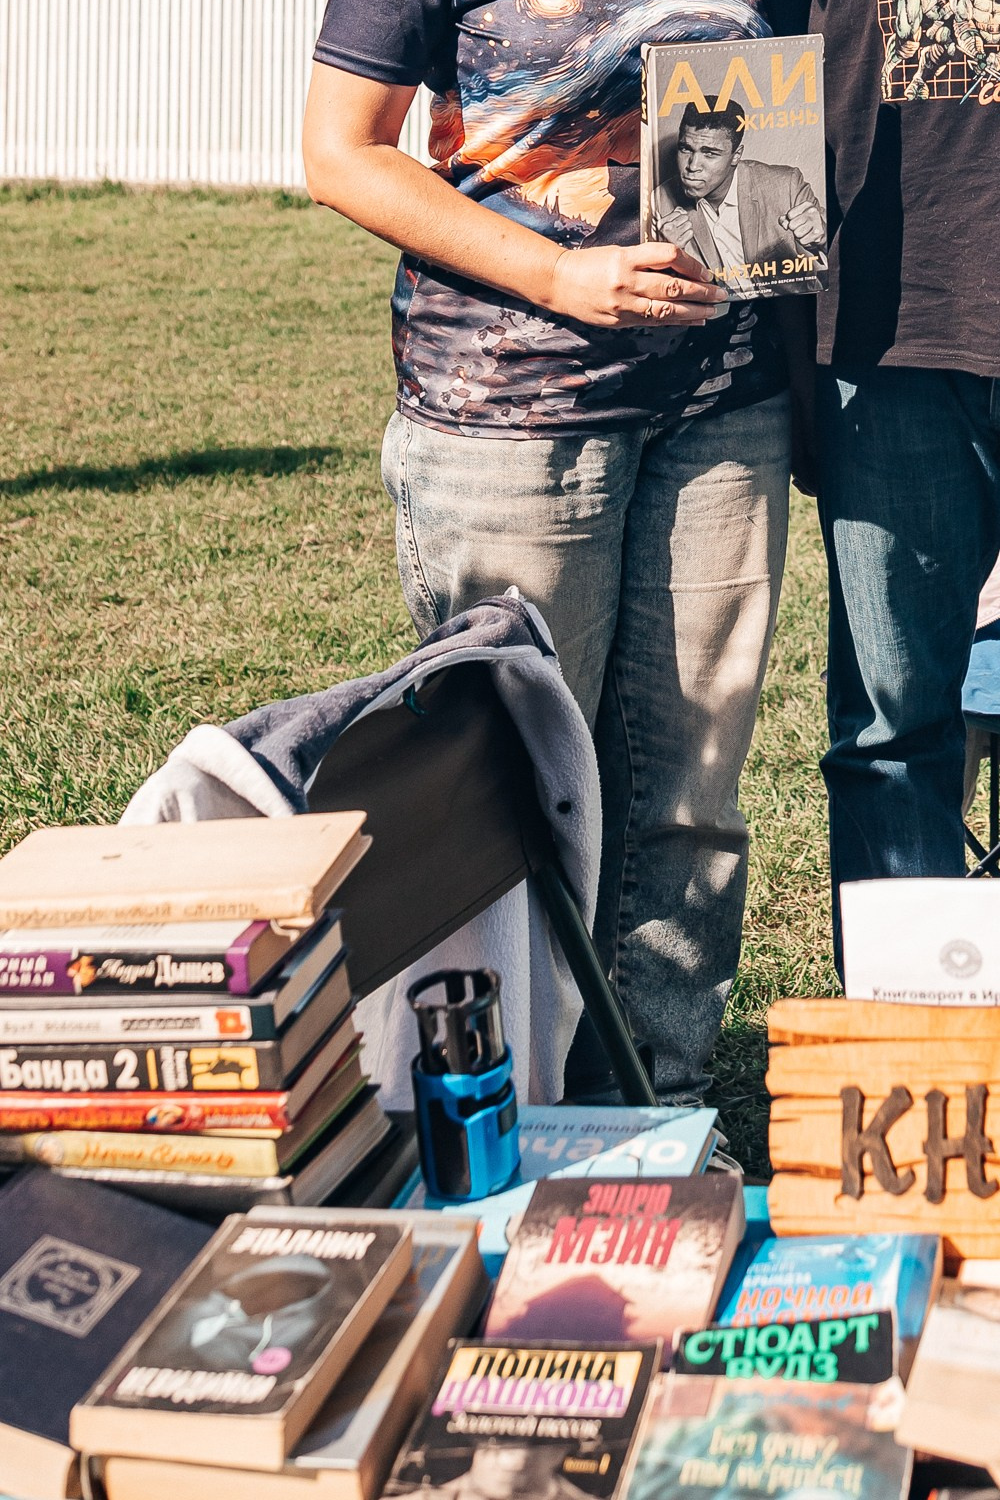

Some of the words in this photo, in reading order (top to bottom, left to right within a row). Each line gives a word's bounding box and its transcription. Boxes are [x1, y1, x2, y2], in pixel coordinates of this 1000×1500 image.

[658, 51, 817, 118] АЛИ
[735, 108, 820, 133] ЖИЗНЬ
[713, 260, 777, 282] НАТАН
[782, 253, 819, 275] ЭЙГ
[0, 1049, 109, 1092] Банда
[113, 1048, 140, 1090] 2
[582, 1183, 673, 1217] ЭНДРЮ
[736, 1282, 874, 1312] НОЧНОЙ
[684, 1313, 880, 1365] СТЮАРТ
[431, 1376, 626, 1417] ДАШКОВА
